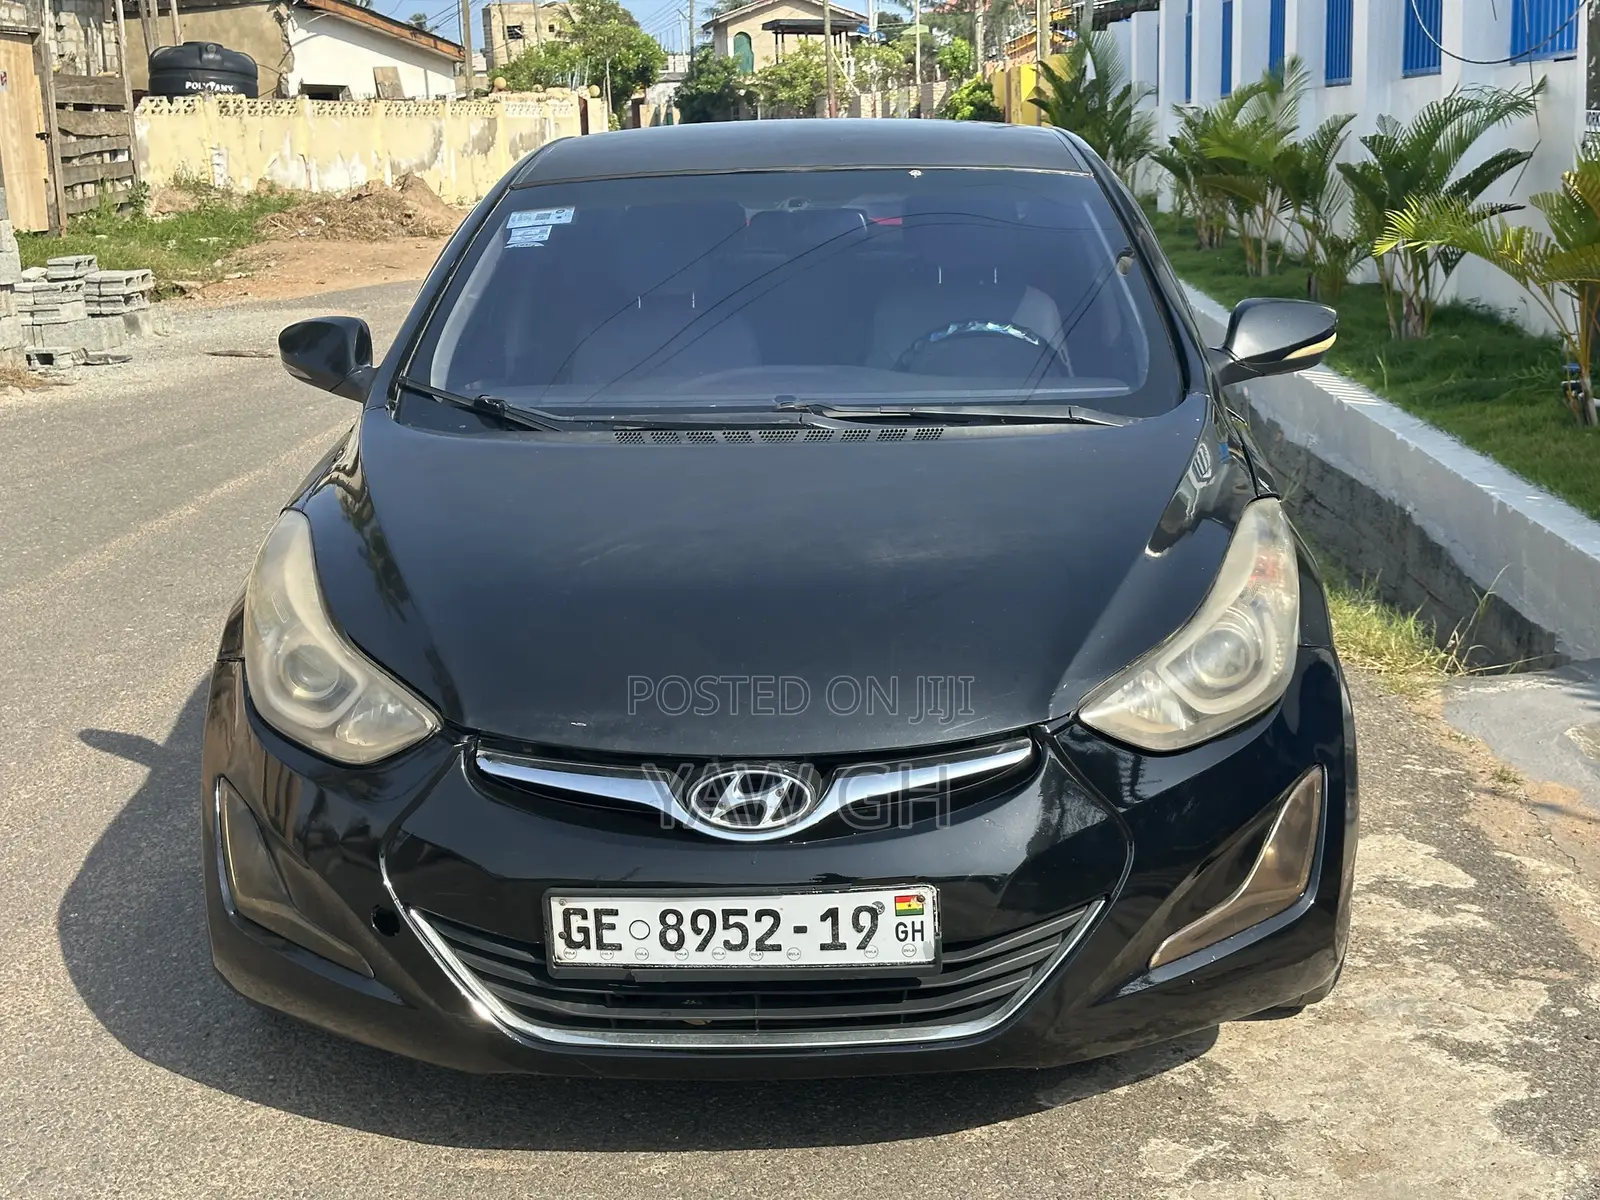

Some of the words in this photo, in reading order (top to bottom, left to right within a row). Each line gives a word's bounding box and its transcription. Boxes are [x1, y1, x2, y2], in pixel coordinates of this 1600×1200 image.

[185, 81, 234, 92] POLYTANK
[562, 907, 623, 950] GE
[658, 905, 879, 952] 8952-19
[894, 920, 925, 942] GH
